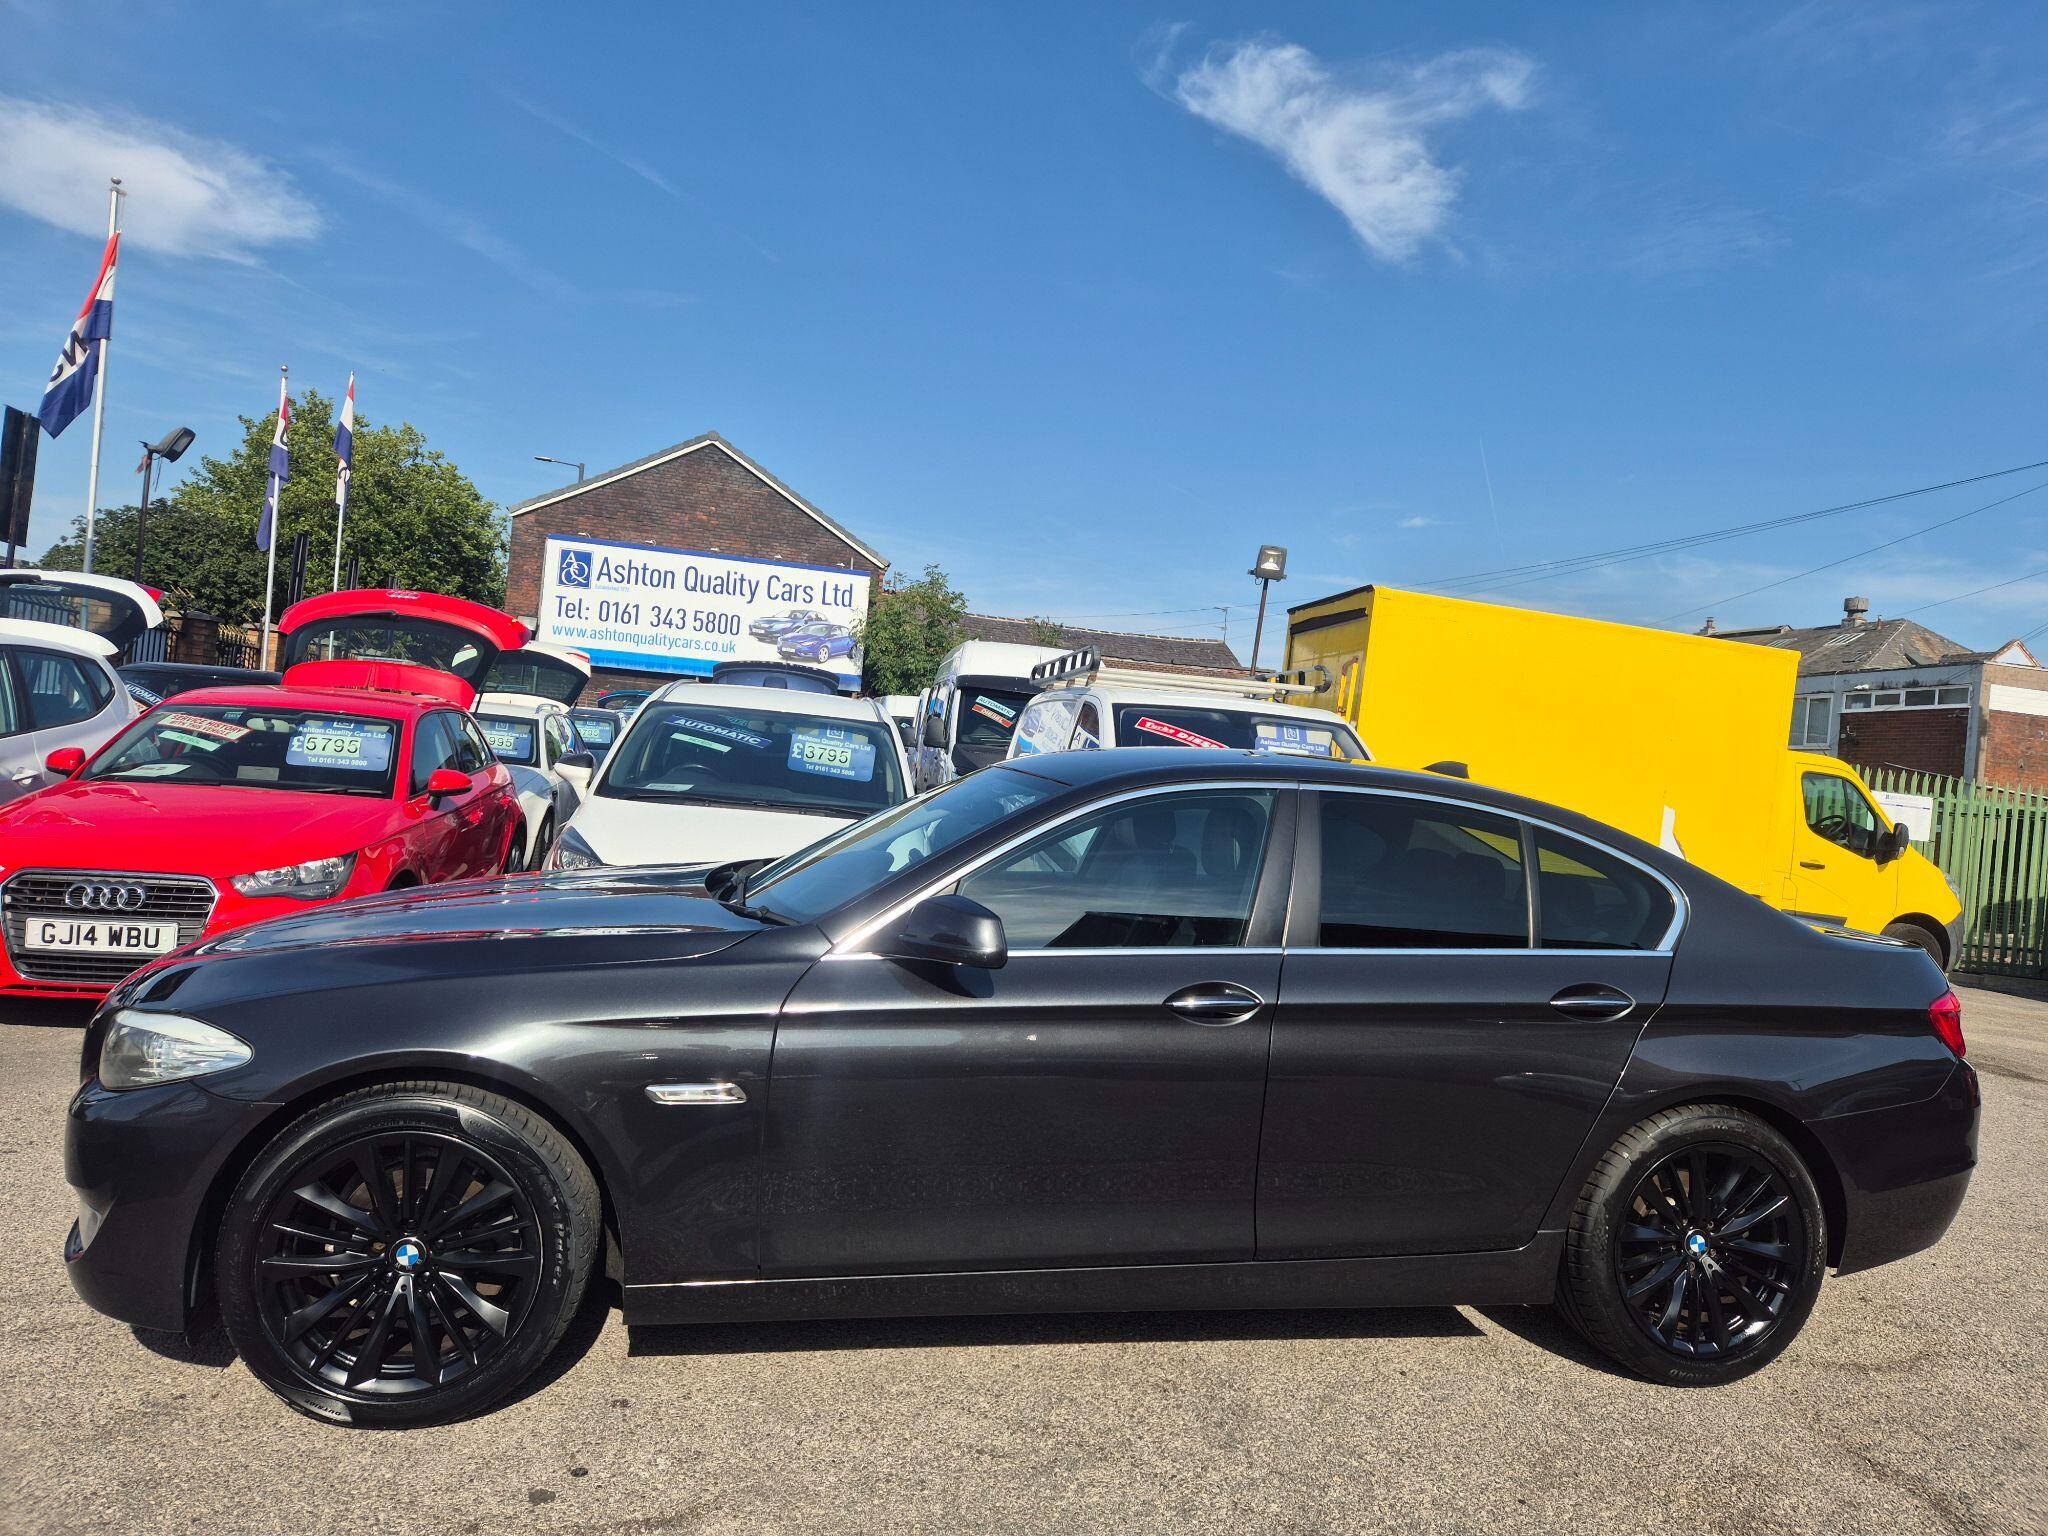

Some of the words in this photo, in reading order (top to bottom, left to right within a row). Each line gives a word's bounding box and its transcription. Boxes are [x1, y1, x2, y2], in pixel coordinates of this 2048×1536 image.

[596, 557, 676, 590] Ashton
[684, 566, 760, 604] Quality
[767, 575, 814, 604] Cars
[821, 581, 854, 608] Ltd
[555, 595, 590, 621] Tel:
[598, 600, 640, 626] 0161
[650, 605, 687, 630] 343
[693, 610, 741, 636] 5800
[552, 625, 736, 654] www.ashtonqualitycars.co.uk
[171, 714, 206, 724] SERVICE
[206, 720, 243, 733] HISTORY
[298, 726, 324, 734] Ashton
[326, 728, 353, 738] Quality
[674, 718, 761, 745] AUTOMATIC
[798, 734, 820, 743] Ashton
[821, 738, 843, 748] Quality
[844, 742, 859, 750] Cars
[1281, 741, 1300, 749] Quality
[41, 922, 98, 946] GJ14
[108, 926, 161, 949] WBU
